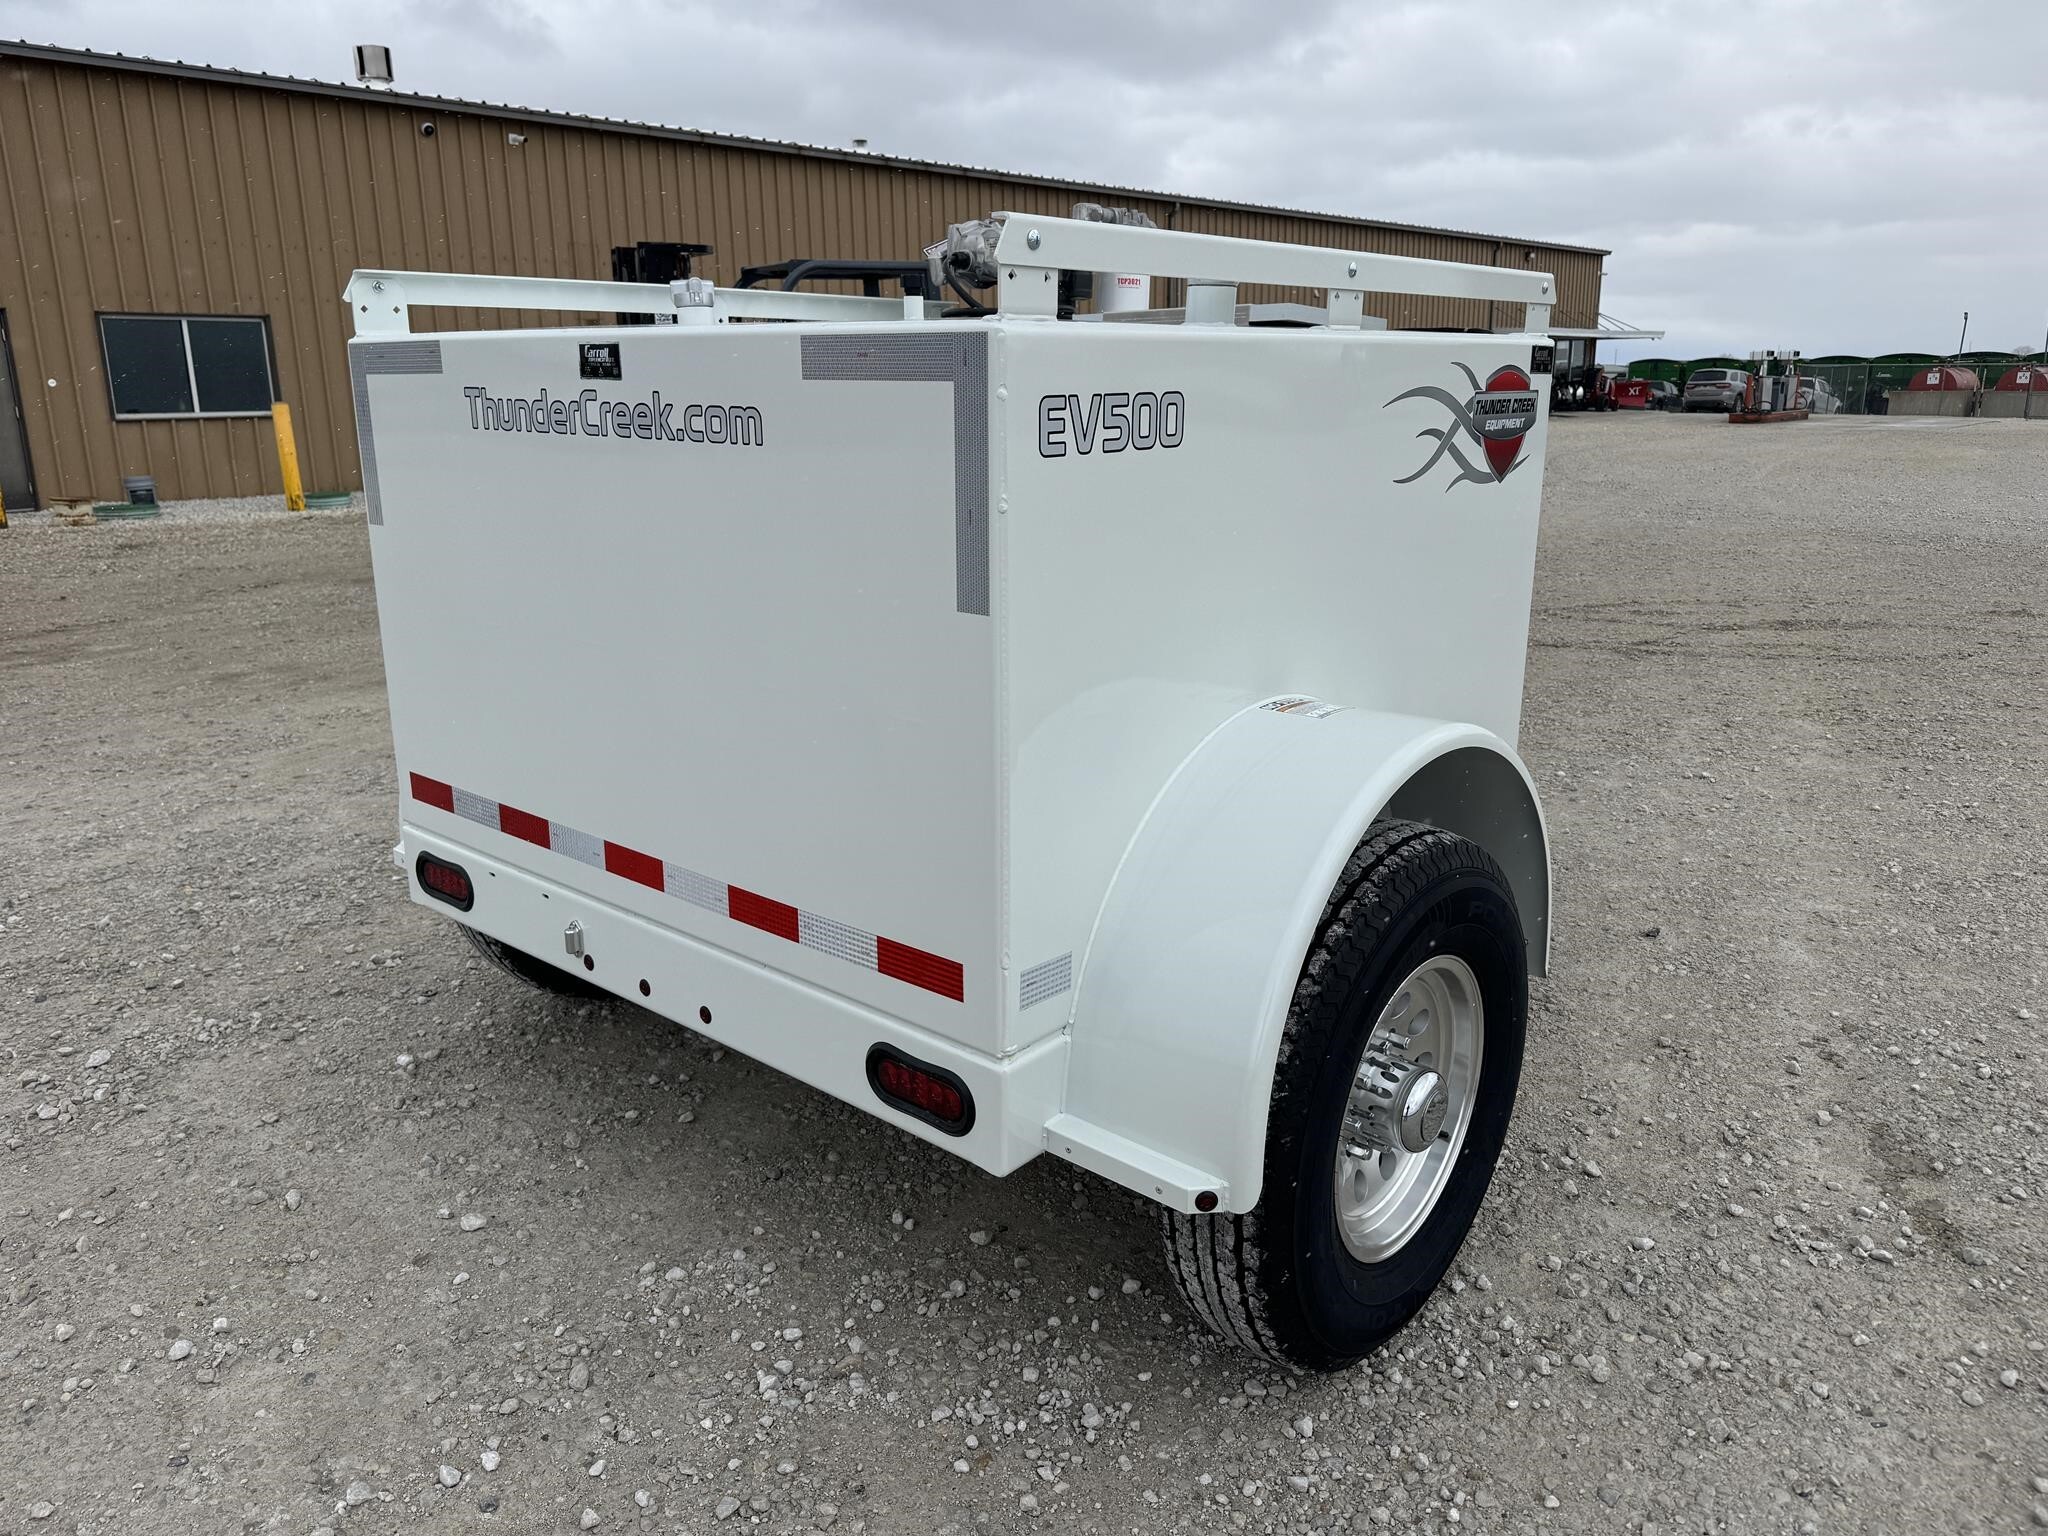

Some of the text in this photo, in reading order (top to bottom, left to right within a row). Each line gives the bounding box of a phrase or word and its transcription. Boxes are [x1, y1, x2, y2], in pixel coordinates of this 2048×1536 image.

[584, 344, 609, 358] Carroll
[1628, 386, 1641, 396] XT
[1475, 397, 1537, 416] THUNDER CREEK
[463, 386, 764, 446] ThunderCreek.com
[1038, 390, 1185, 458] EV500
[1484, 417, 1526, 431] EQUIPMENT
